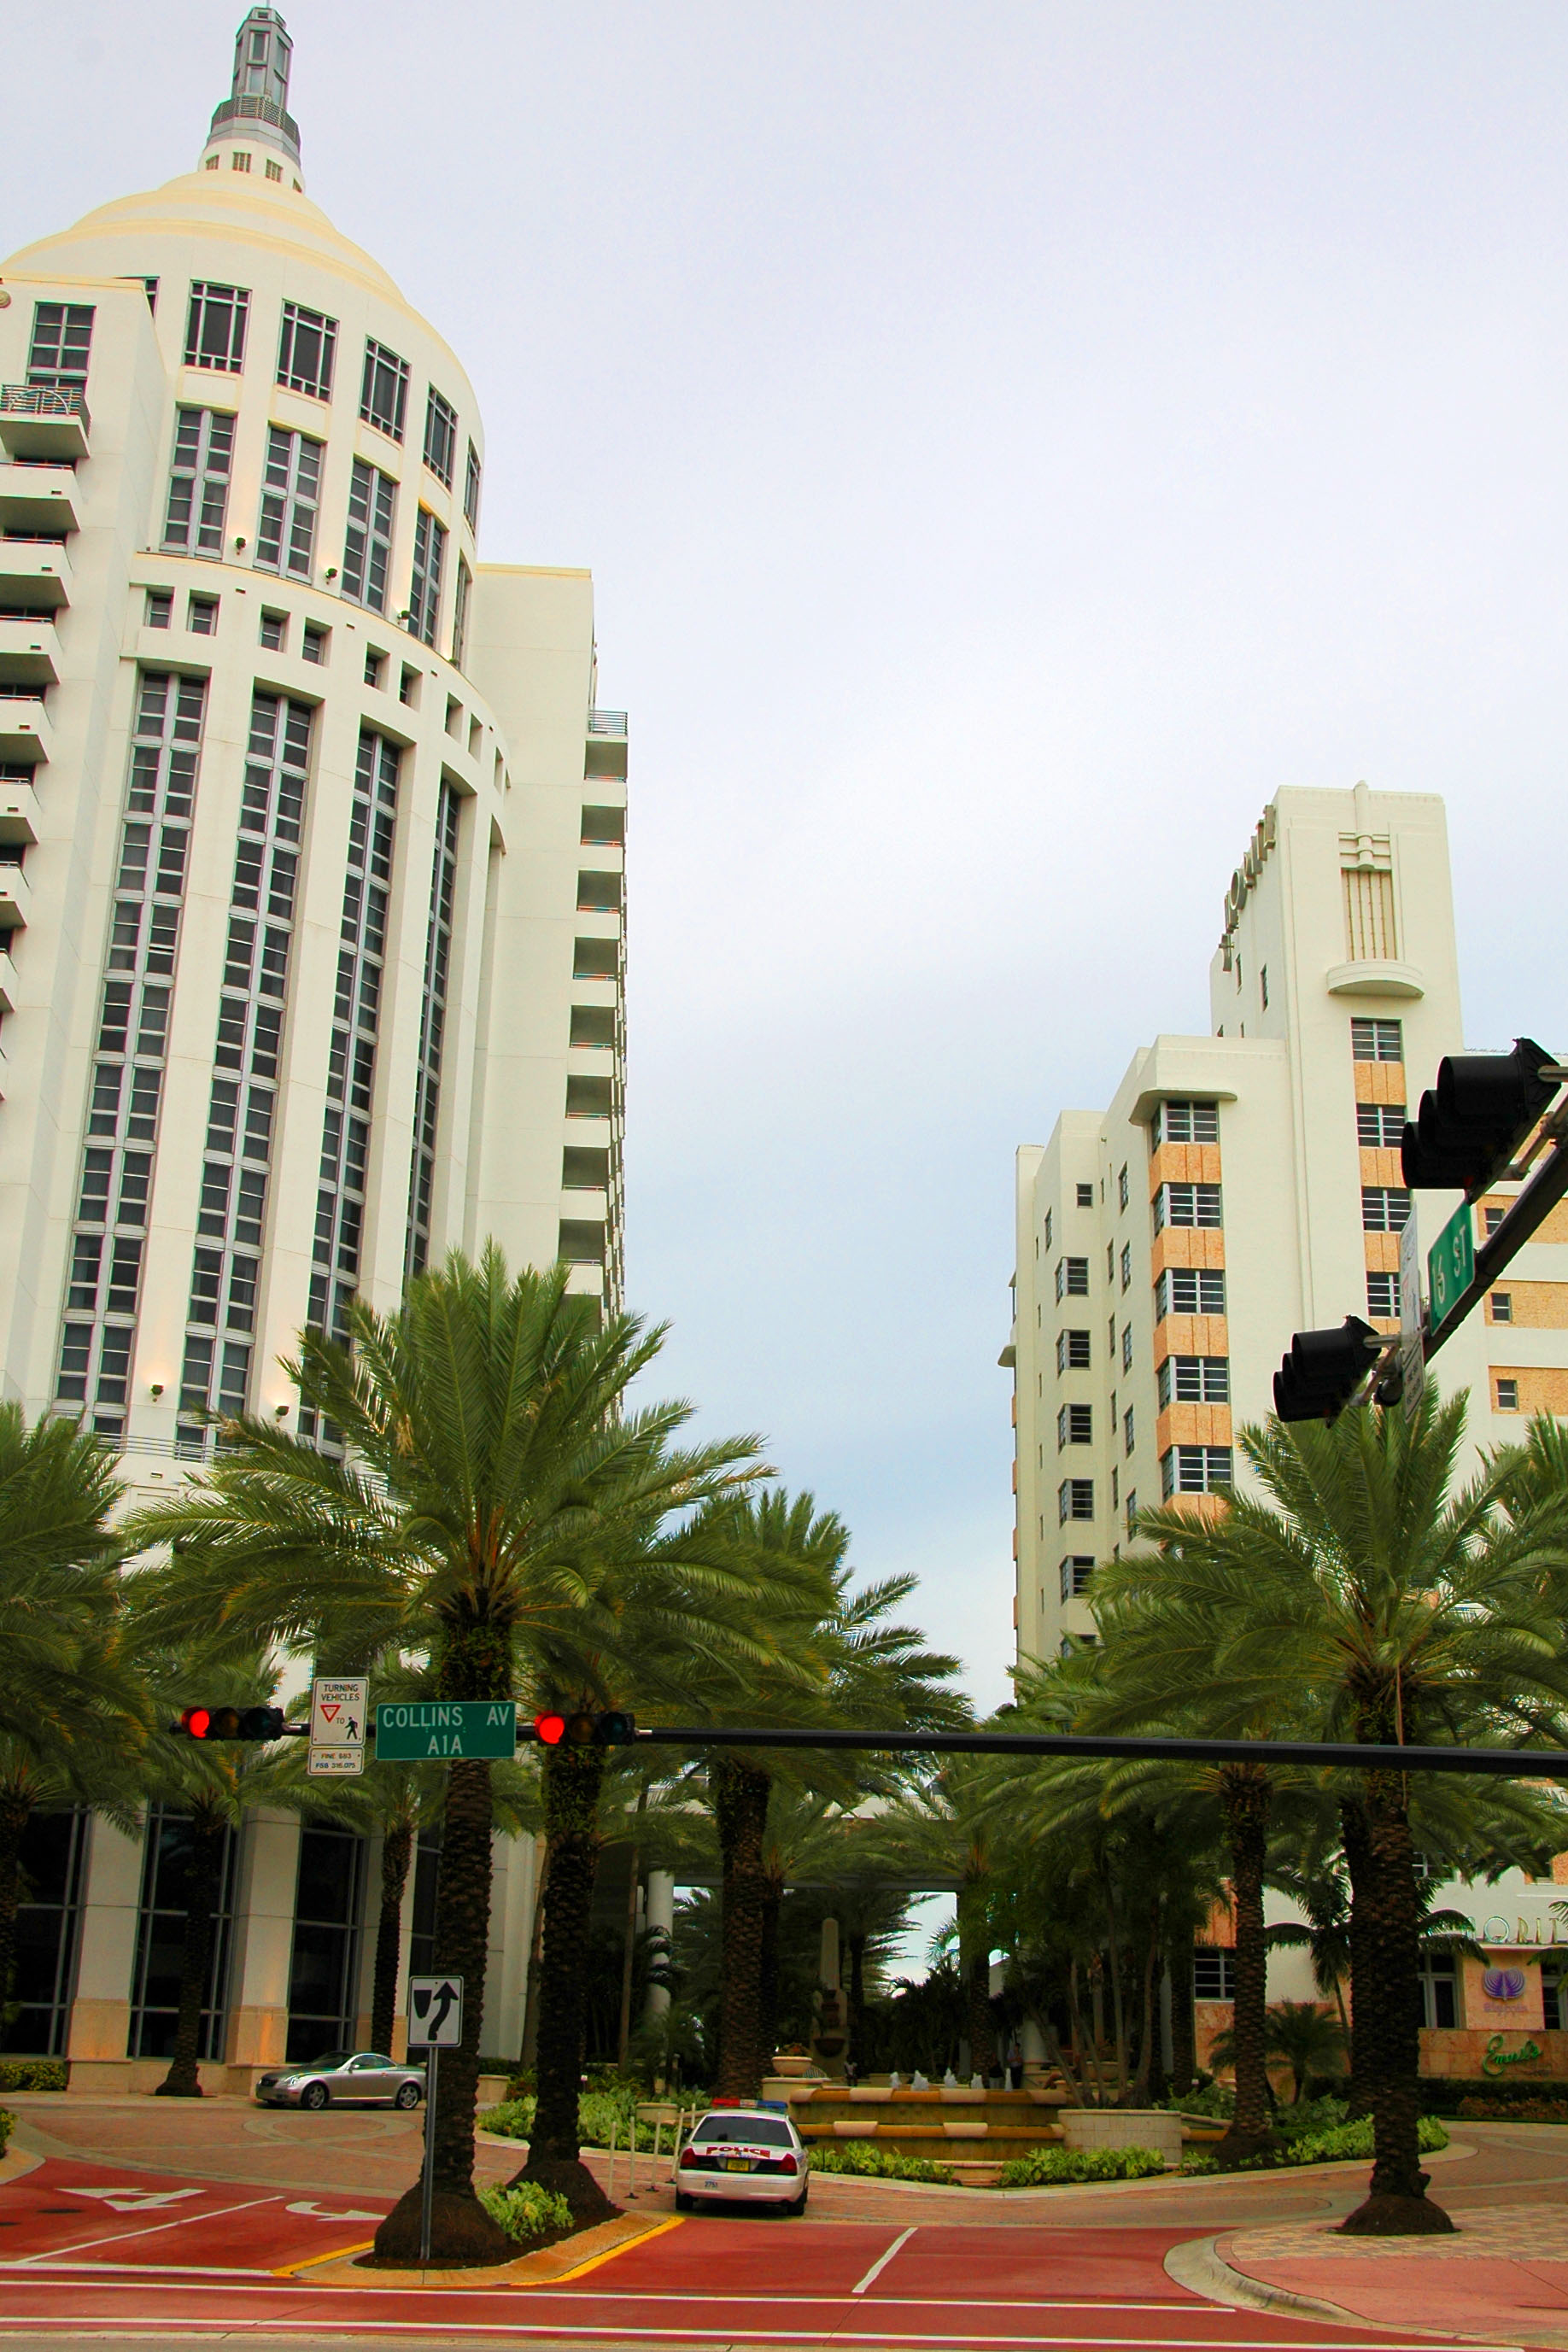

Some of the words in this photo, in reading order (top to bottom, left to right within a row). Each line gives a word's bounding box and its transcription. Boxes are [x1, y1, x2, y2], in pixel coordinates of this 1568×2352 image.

[1453, 1225, 1466, 1278] ST
[324, 1683, 359, 1693] TURNING
[321, 1693, 360, 1702] VEHICLES
[336, 1717, 346, 1725] TO
[383, 1706, 463, 1728] COLLINS
[486, 1705, 511, 1726] AV
[427, 1735, 463, 1755] A1A
[706, 2146, 771, 2159] POLICE
